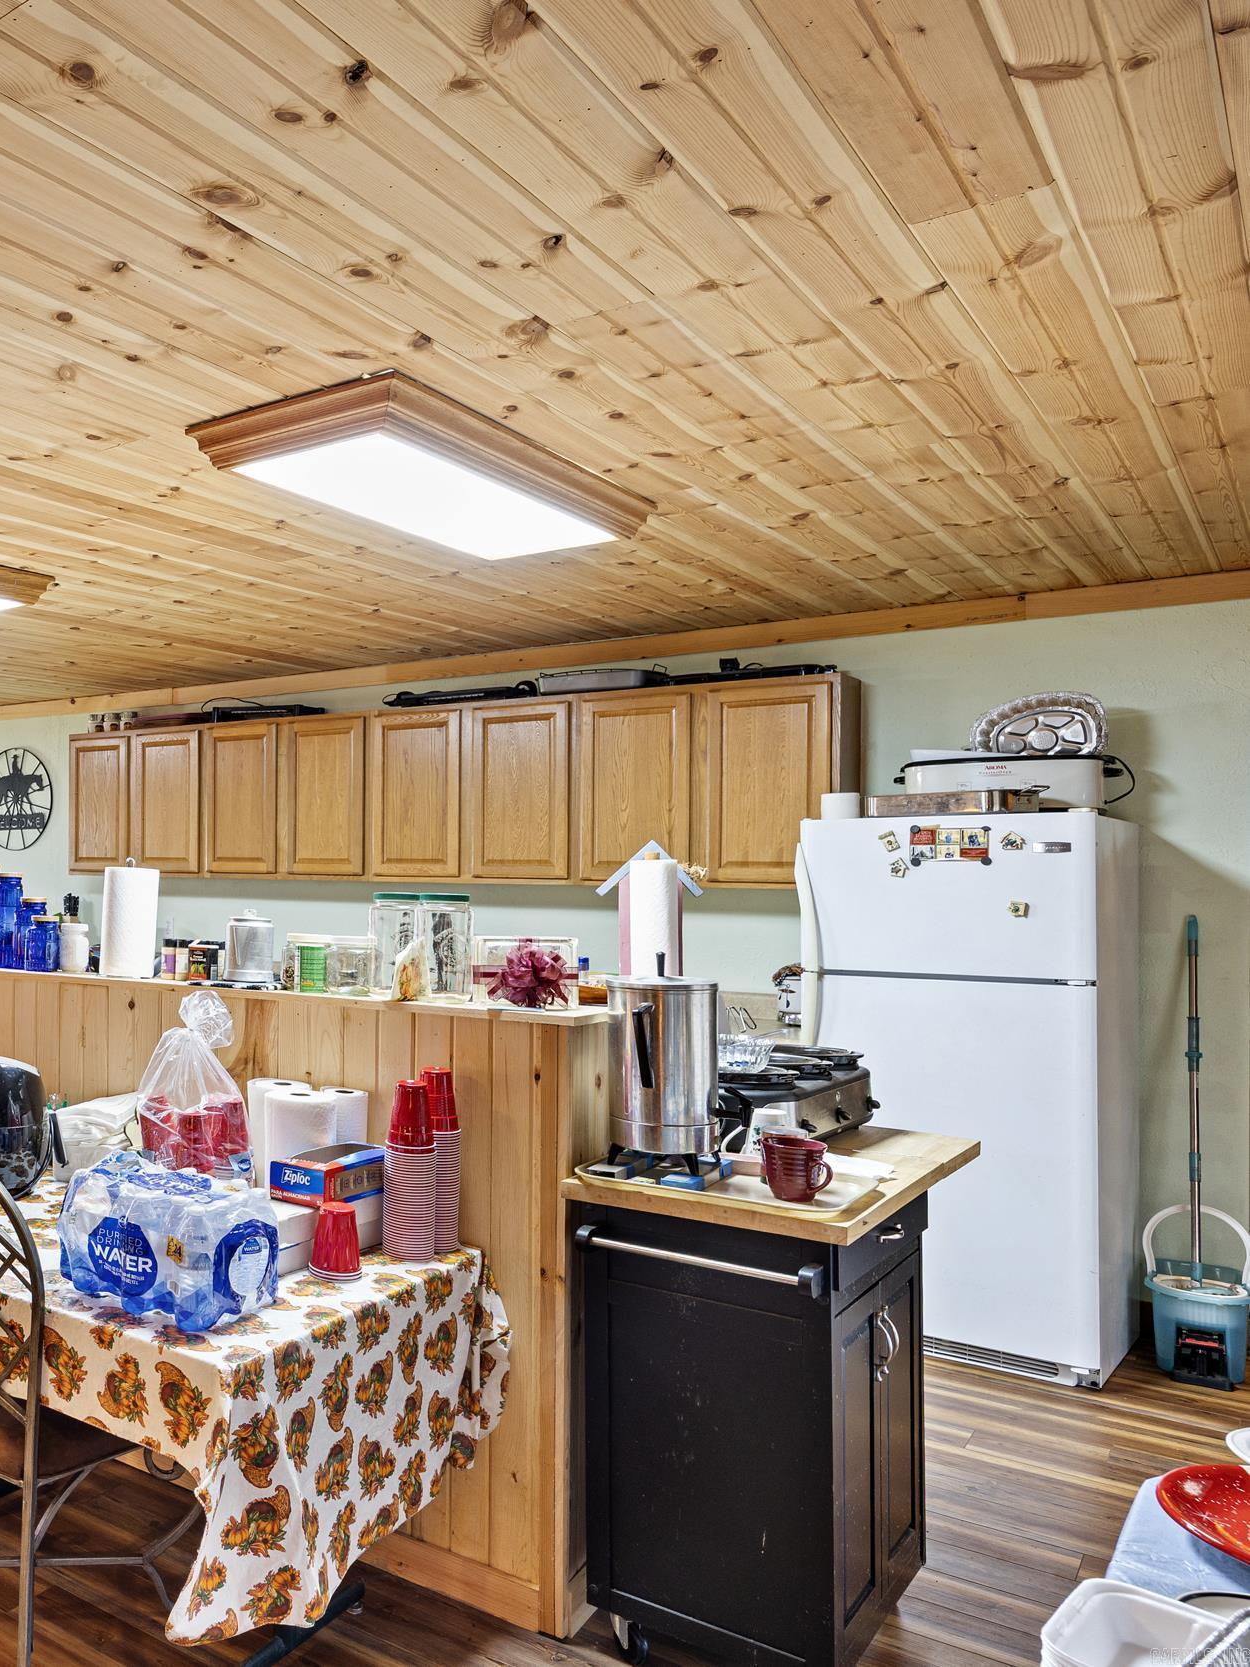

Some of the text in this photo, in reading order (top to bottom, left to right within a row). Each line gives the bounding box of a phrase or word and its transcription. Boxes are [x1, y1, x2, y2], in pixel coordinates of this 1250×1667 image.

[283, 1169, 311, 1186] Ziploc
[96, 1235, 144, 1256] DRINNG
[98, 1228, 143, 1247] PURED
[90, 1240, 153, 1273] WATER
